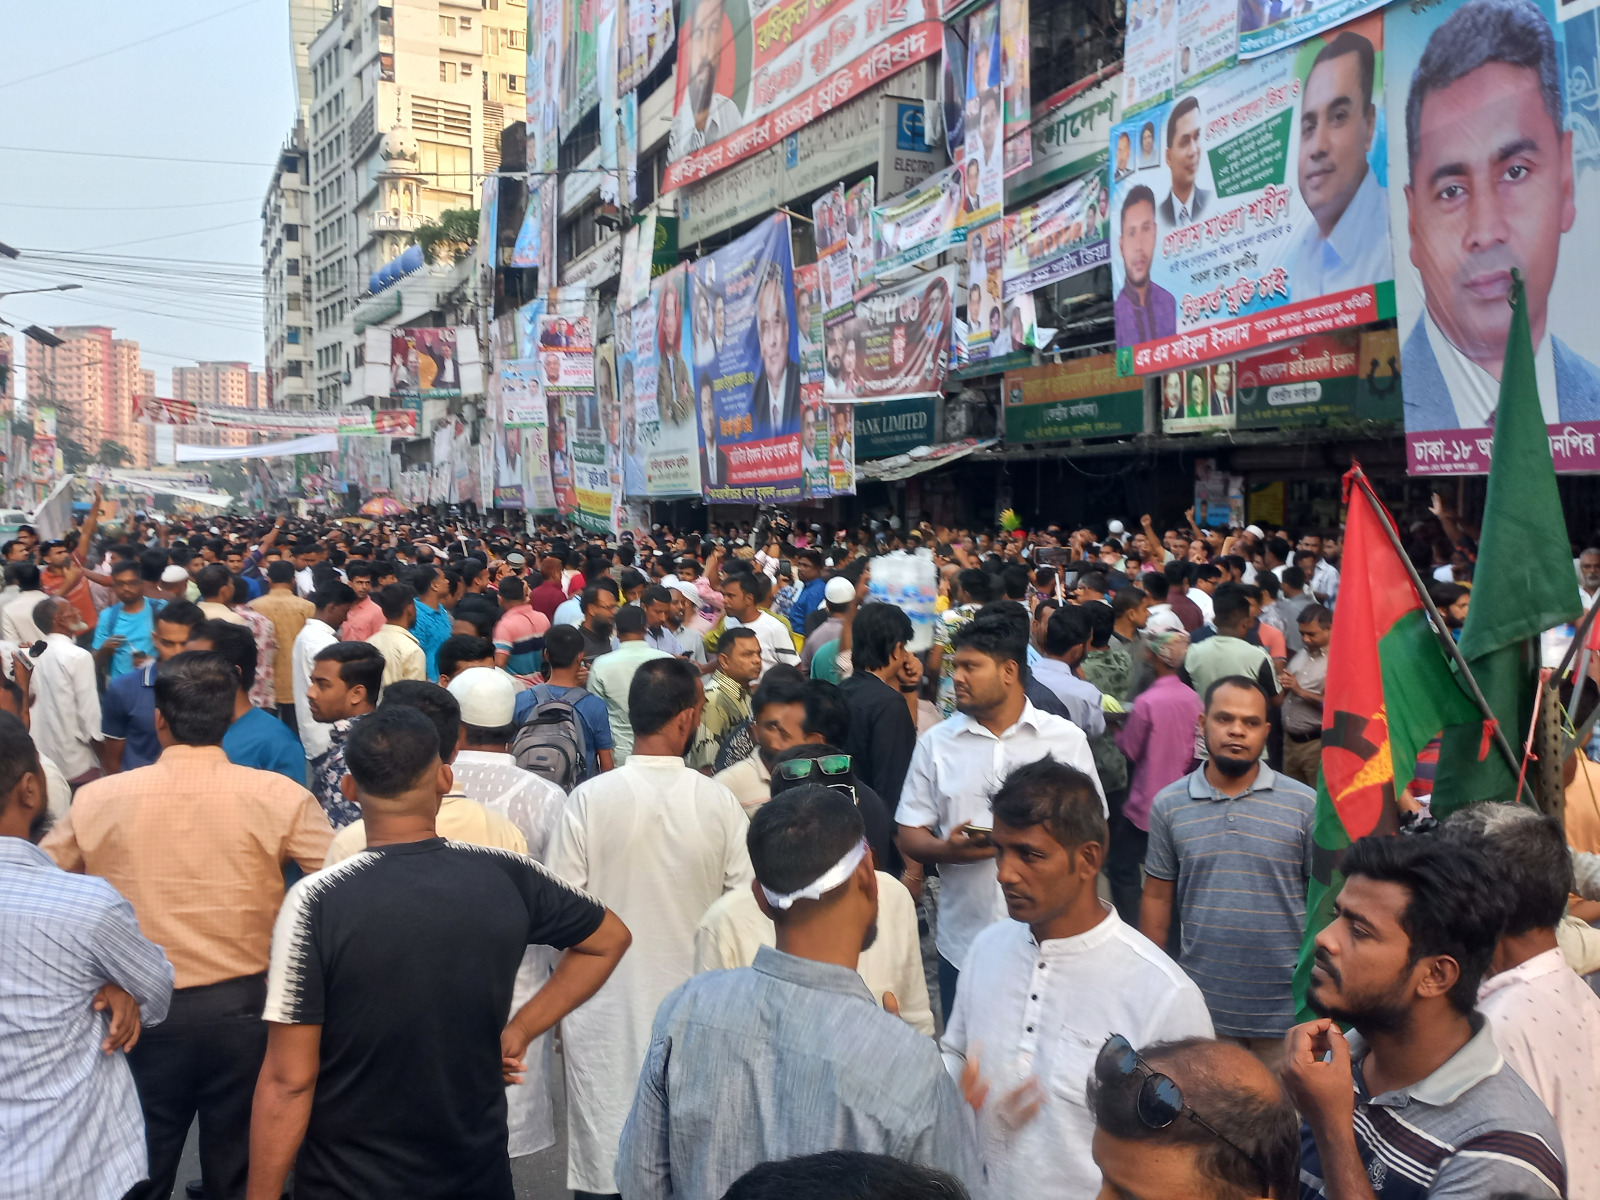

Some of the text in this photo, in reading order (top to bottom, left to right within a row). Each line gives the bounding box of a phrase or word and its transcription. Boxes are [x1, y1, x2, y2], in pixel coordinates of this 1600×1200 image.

[810, 15, 859, 76] মুক্তি
[669, 146, 724, 184] রফিকুল
[817, 68, 853, 112] মুক্তি
[858, 30, 928, 83] পরিষদ
[894, 157, 935, 174] ELECTRO
[1204, 205, 1247, 243] মাওলা
[1224, 276, 1257, 317] মুক্তি
[1257, 266, 1289, 299] চাই
[1135, 322, 1252, 367] এম এম সাইফুল ইসলাম
[854, 411, 928, 436] BANK LIMITED
[1412, 438, 1473, 463] ঢাকা-১৮
